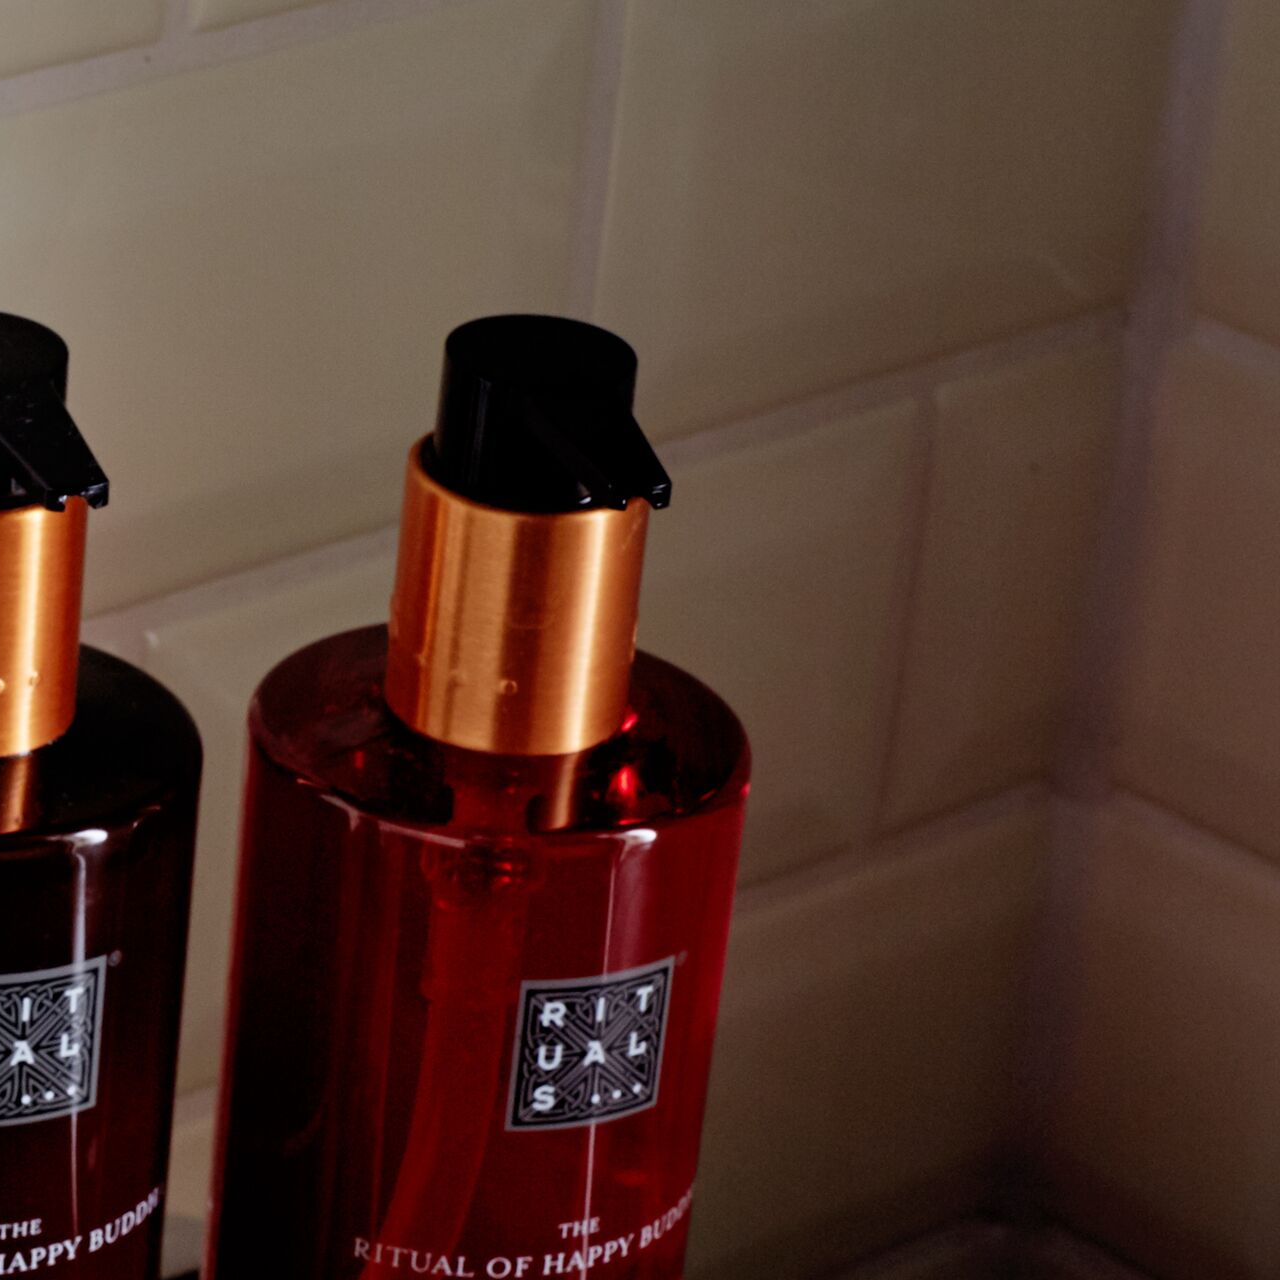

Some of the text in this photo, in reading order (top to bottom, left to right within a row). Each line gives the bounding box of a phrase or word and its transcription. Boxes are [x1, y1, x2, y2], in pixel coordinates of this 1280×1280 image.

[557, 1216, 601, 1240] THE
[353, 1236, 475, 1279] RITUAL
[486, 1256, 533, 1279] OF
[542, 1233, 635, 1277] HAPPY
